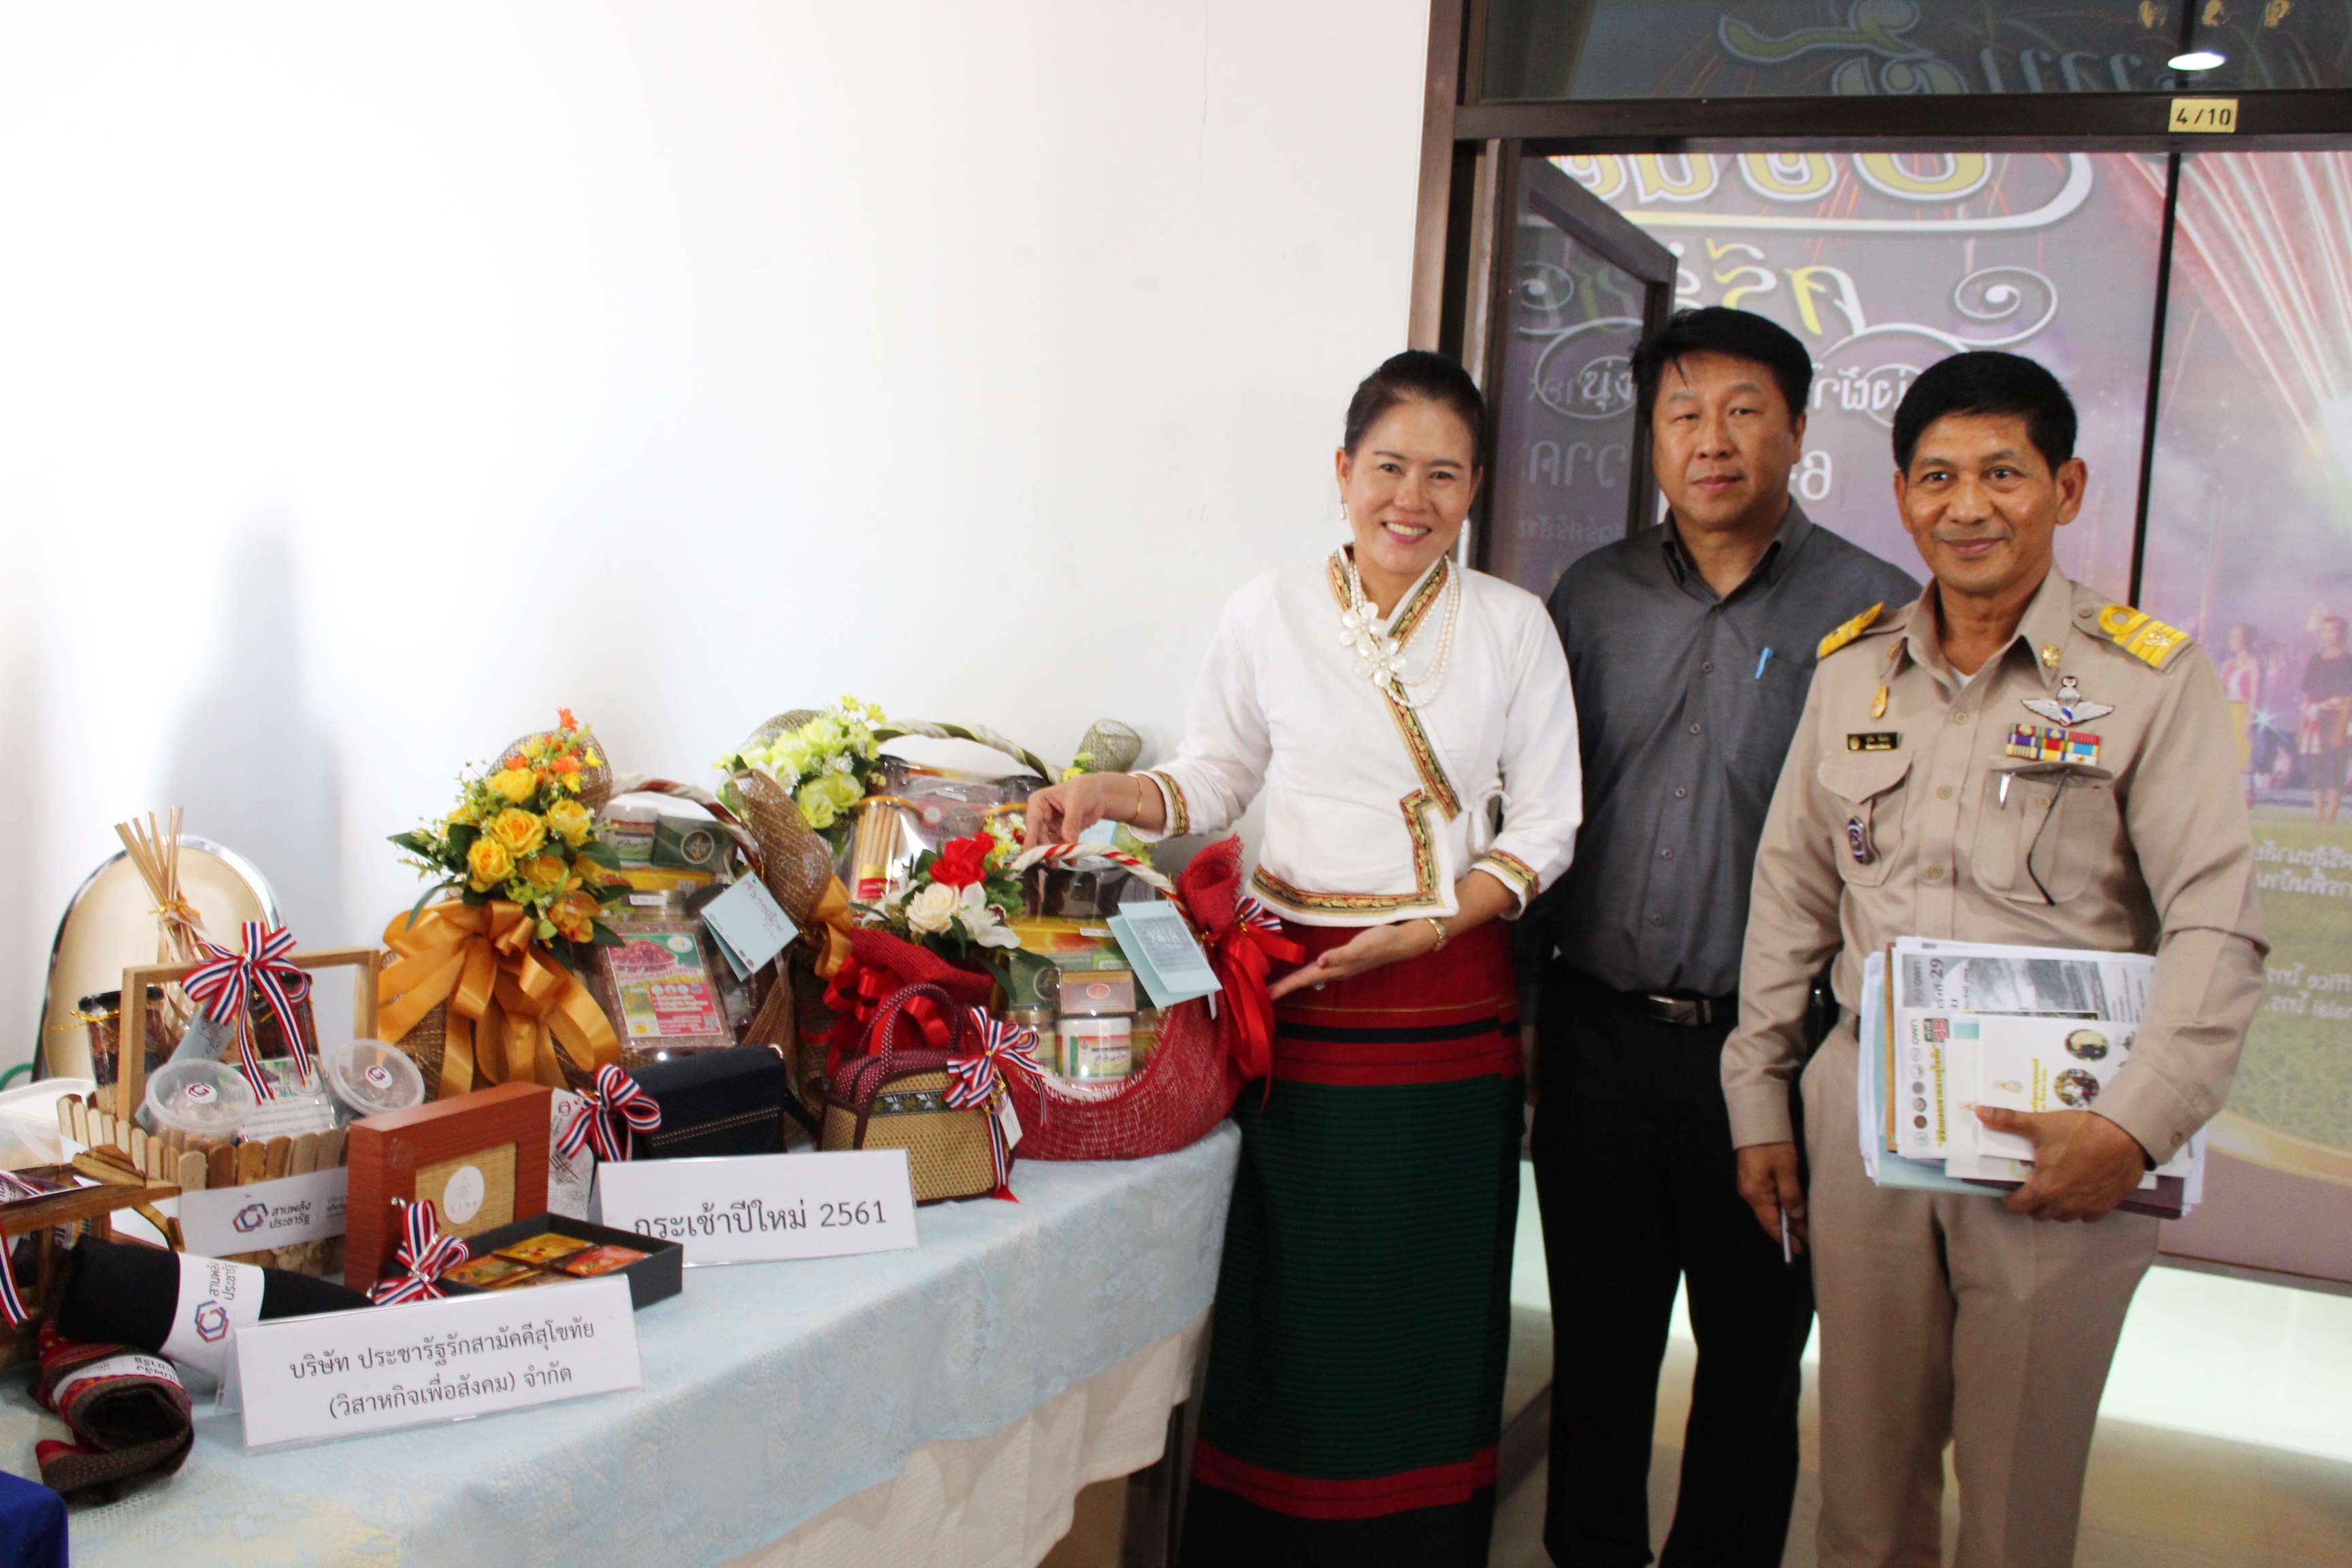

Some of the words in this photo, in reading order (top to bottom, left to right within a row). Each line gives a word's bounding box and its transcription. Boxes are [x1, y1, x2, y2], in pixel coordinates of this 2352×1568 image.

[2175, 108, 2232, 126] 4/10
[1929, 958, 1945, 979] 29
[269, 1213, 310, 1229] ประชารัฐ
[271, 1198, 312, 1217] สานพลัง
[634, 1198, 807, 1239] กระเช้าปีใหม่
[819, 1199, 887, 1228] 2561
[206, 1261, 221, 1297] สานพลัง
[221, 1263, 238, 1301] ประชารัฐ
[289, 1349, 350, 1379] บริษัท
[358, 1316, 595, 1369] ประชารัฐรักสามัคคีสุโขทัย
[329, 1371, 516, 1420] (วิสาหกิจเพื่อสังคม)
[523, 1360, 573, 1389] จำกัด
